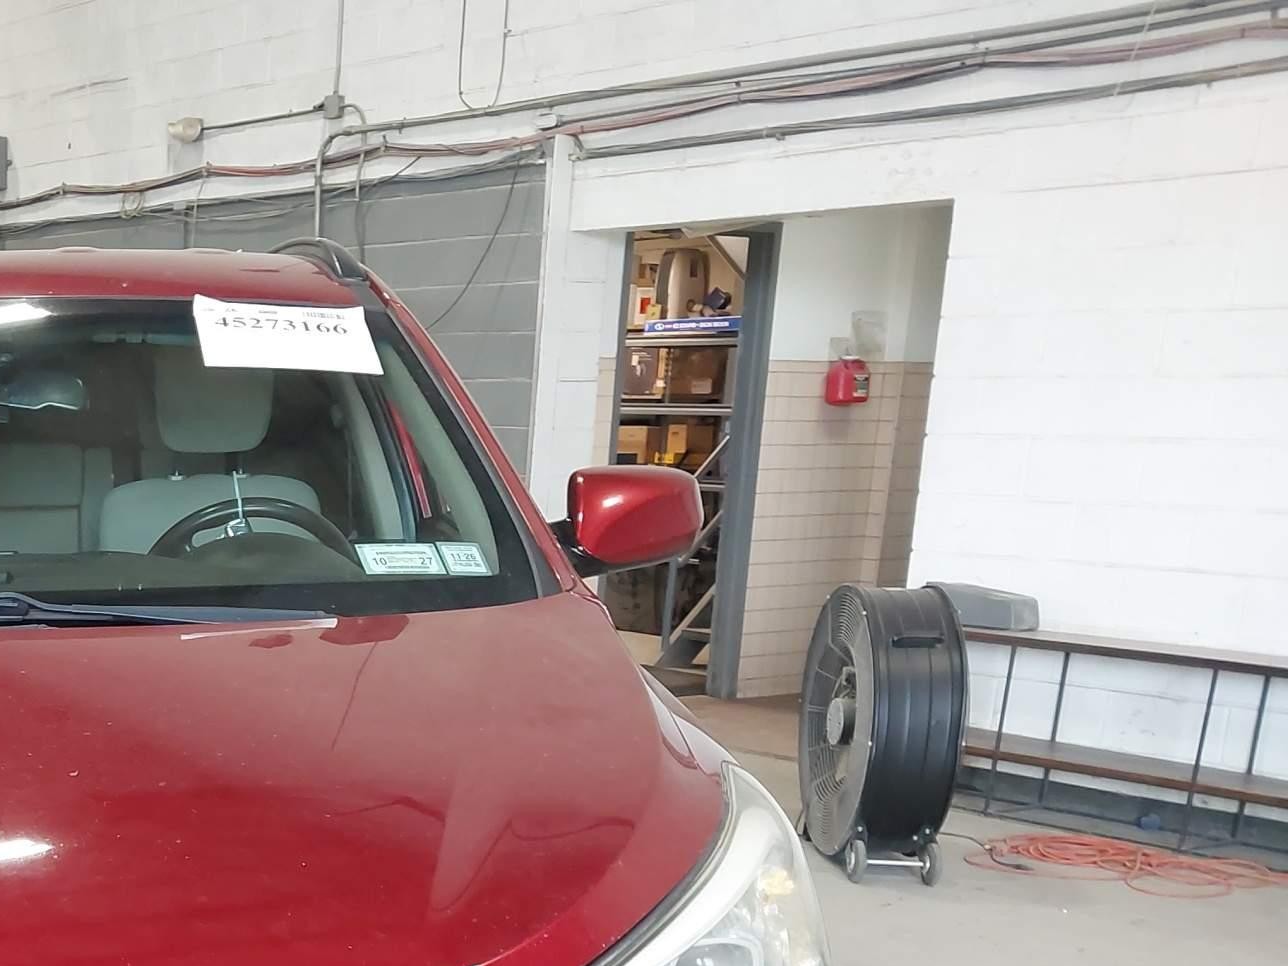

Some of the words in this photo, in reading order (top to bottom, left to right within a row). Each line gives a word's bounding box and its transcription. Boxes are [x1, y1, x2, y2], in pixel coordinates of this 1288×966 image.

[215, 316, 348, 335] 45273166
[372, 556, 388, 566] 10
[418, 556, 433, 566] 27
